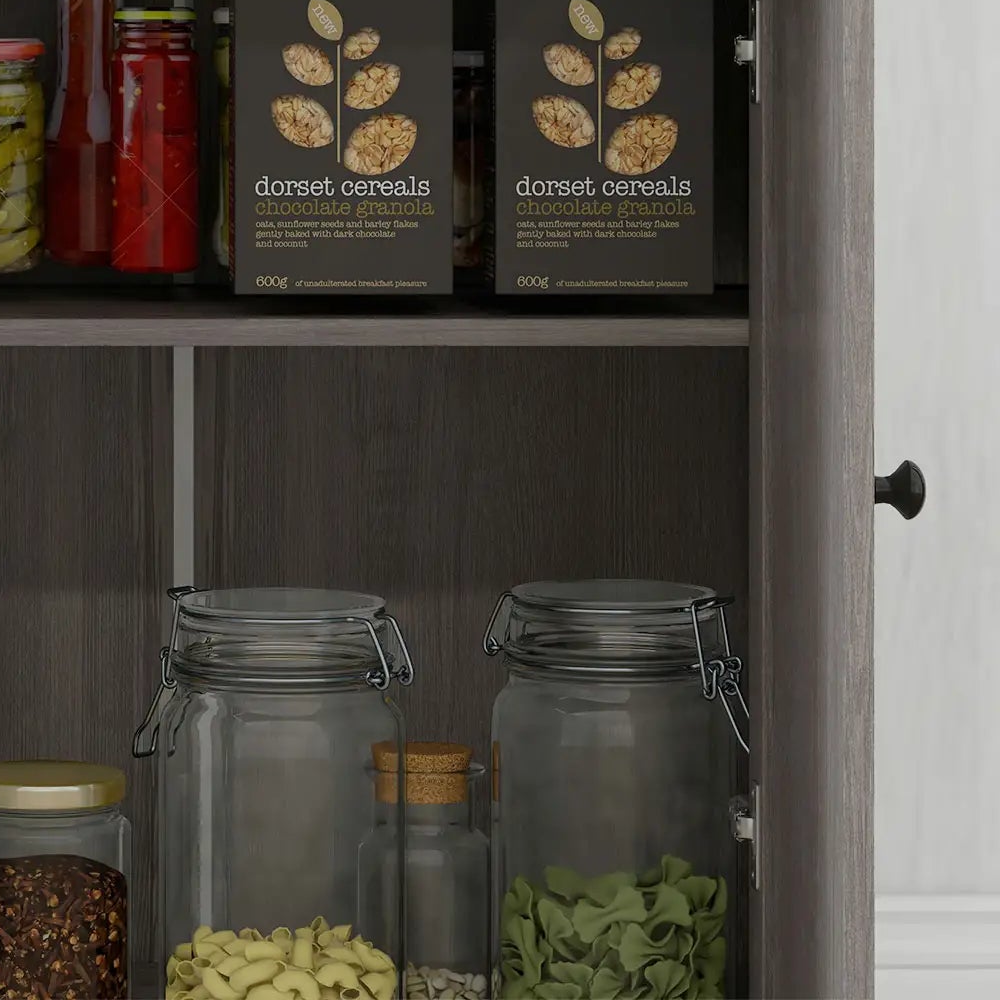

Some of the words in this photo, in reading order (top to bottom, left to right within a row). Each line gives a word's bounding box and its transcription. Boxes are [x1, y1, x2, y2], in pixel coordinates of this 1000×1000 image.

[312, 3, 338, 34] new
[574, 3, 600, 34] new
[255, 176, 335, 197] dorset
[342, 176, 430, 197] cereals
[516, 176, 596, 197] dorset
[603, 176, 691, 197] cereals
[256, 199, 351, 216] chocolate
[357, 199, 434, 218] granola
[517, 199, 612, 216] chocolate
[618, 199, 695, 218] granola
[256, 220, 276, 230] oats,
[277, 219, 319, 229] sunflower
[320, 219, 344, 229] seeds
[346, 219, 363, 229] and
[364, 219, 391, 230] barley
[394, 219, 419, 229] flakes
[538, 219, 580, 229] sunflower
[581, 219, 605, 229] seeds
[607, 219, 624, 229] and
[655, 219, 680, 229] flakes
[256, 229, 283, 240] gently
[285, 229, 310, 239] baked
[312, 229, 332, 239] with
[333, 229, 354, 239] dark
[355, 229, 395, 239] chocolate
[546, 229, 571, 239] baked
[573, 229, 593, 239] with
[594, 229, 615, 239] dark
[616, 229, 656, 239] chocolate
[255, 239, 273, 249] and
[274, 239, 308, 249] coconut
[516, 239, 534, 249] and
[535, 239, 569, 249] coconut
[255, 275, 288, 290] 600g
[295, 279, 303, 288] of
[516, 275, 549, 290] 600g
